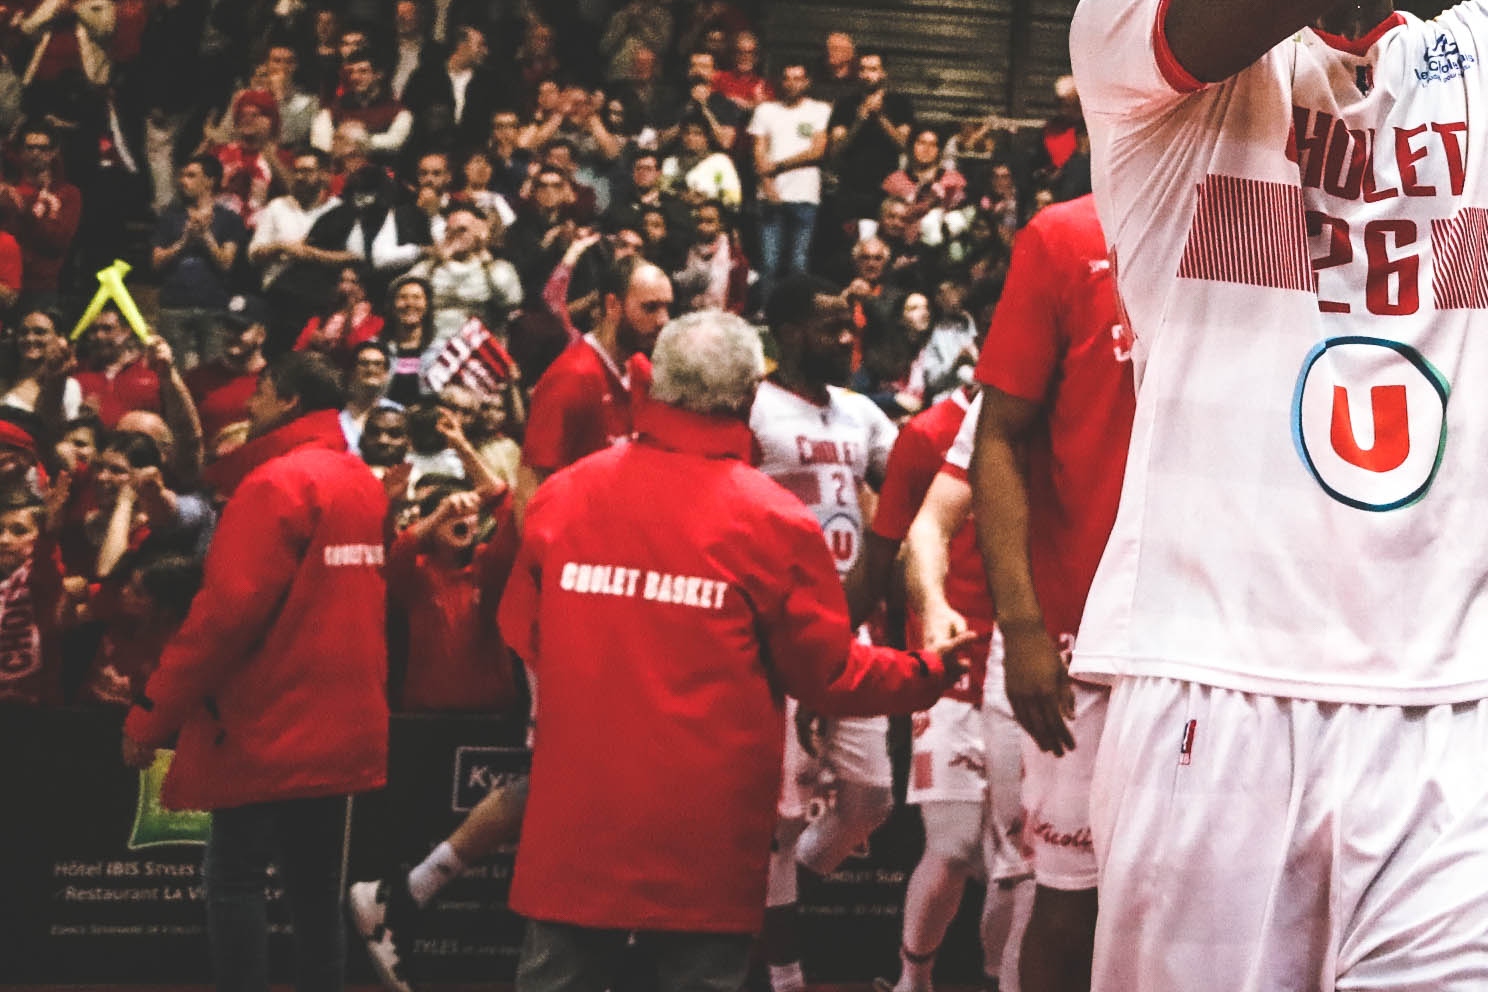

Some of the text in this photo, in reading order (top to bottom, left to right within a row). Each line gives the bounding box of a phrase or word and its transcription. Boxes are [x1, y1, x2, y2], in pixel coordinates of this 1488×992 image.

[1305, 210, 1420, 316] 26
[1330, 383, 1411, 474] U
[560, 561, 728, 610] CHOLET BASKET
[64, 885, 159, 902] Restaurant
[105, 860, 140, 878] IBIS
